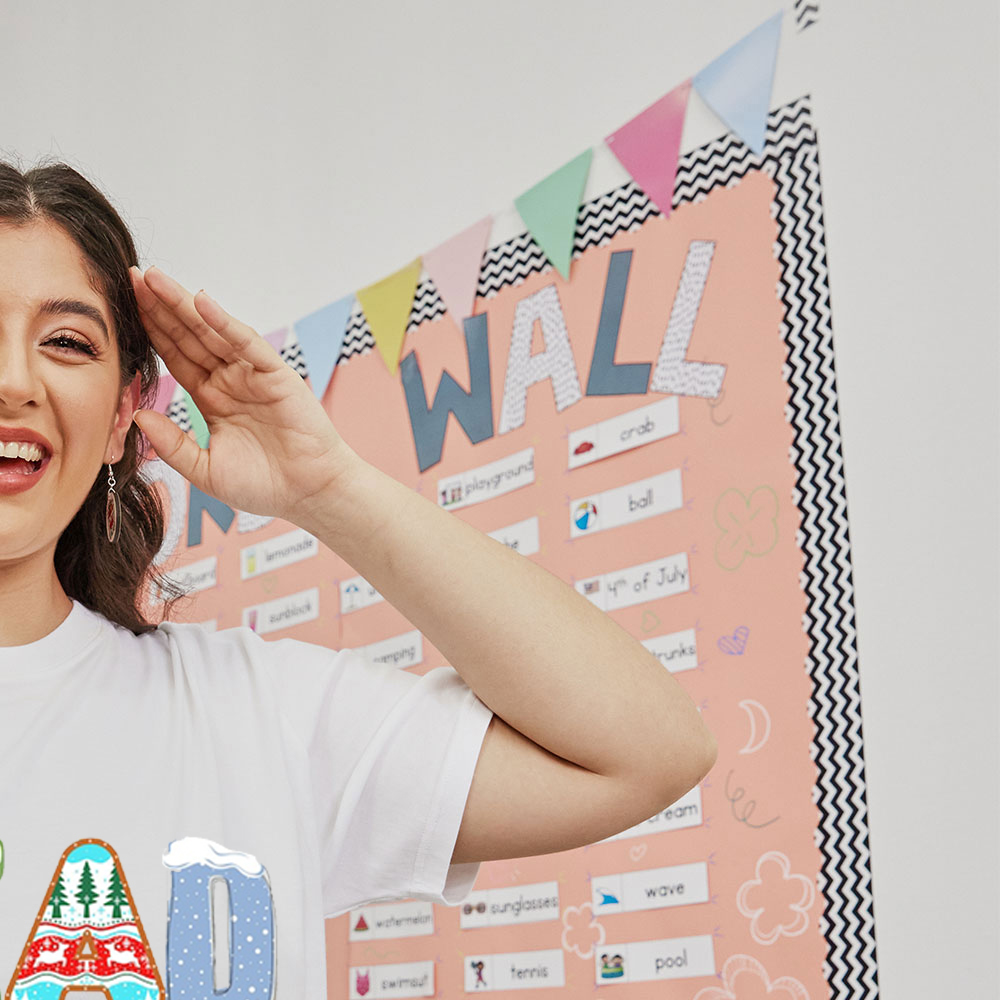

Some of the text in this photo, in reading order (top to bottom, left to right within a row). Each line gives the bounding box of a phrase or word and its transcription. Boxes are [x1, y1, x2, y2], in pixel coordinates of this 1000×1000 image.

[399, 240, 727, 473] WALL
[620, 416, 655, 441] crab
[465, 461, 534, 496] playground
[628, 489, 654, 511] ball
[633, 573, 649, 592] of
[656, 566, 688, 587] July
[645, 883, 685, 899] wave
[490, 895, 558, 917] sunglasses
[511, 963, 549, 980] tennis
[656, 948, 687, 974] pool
